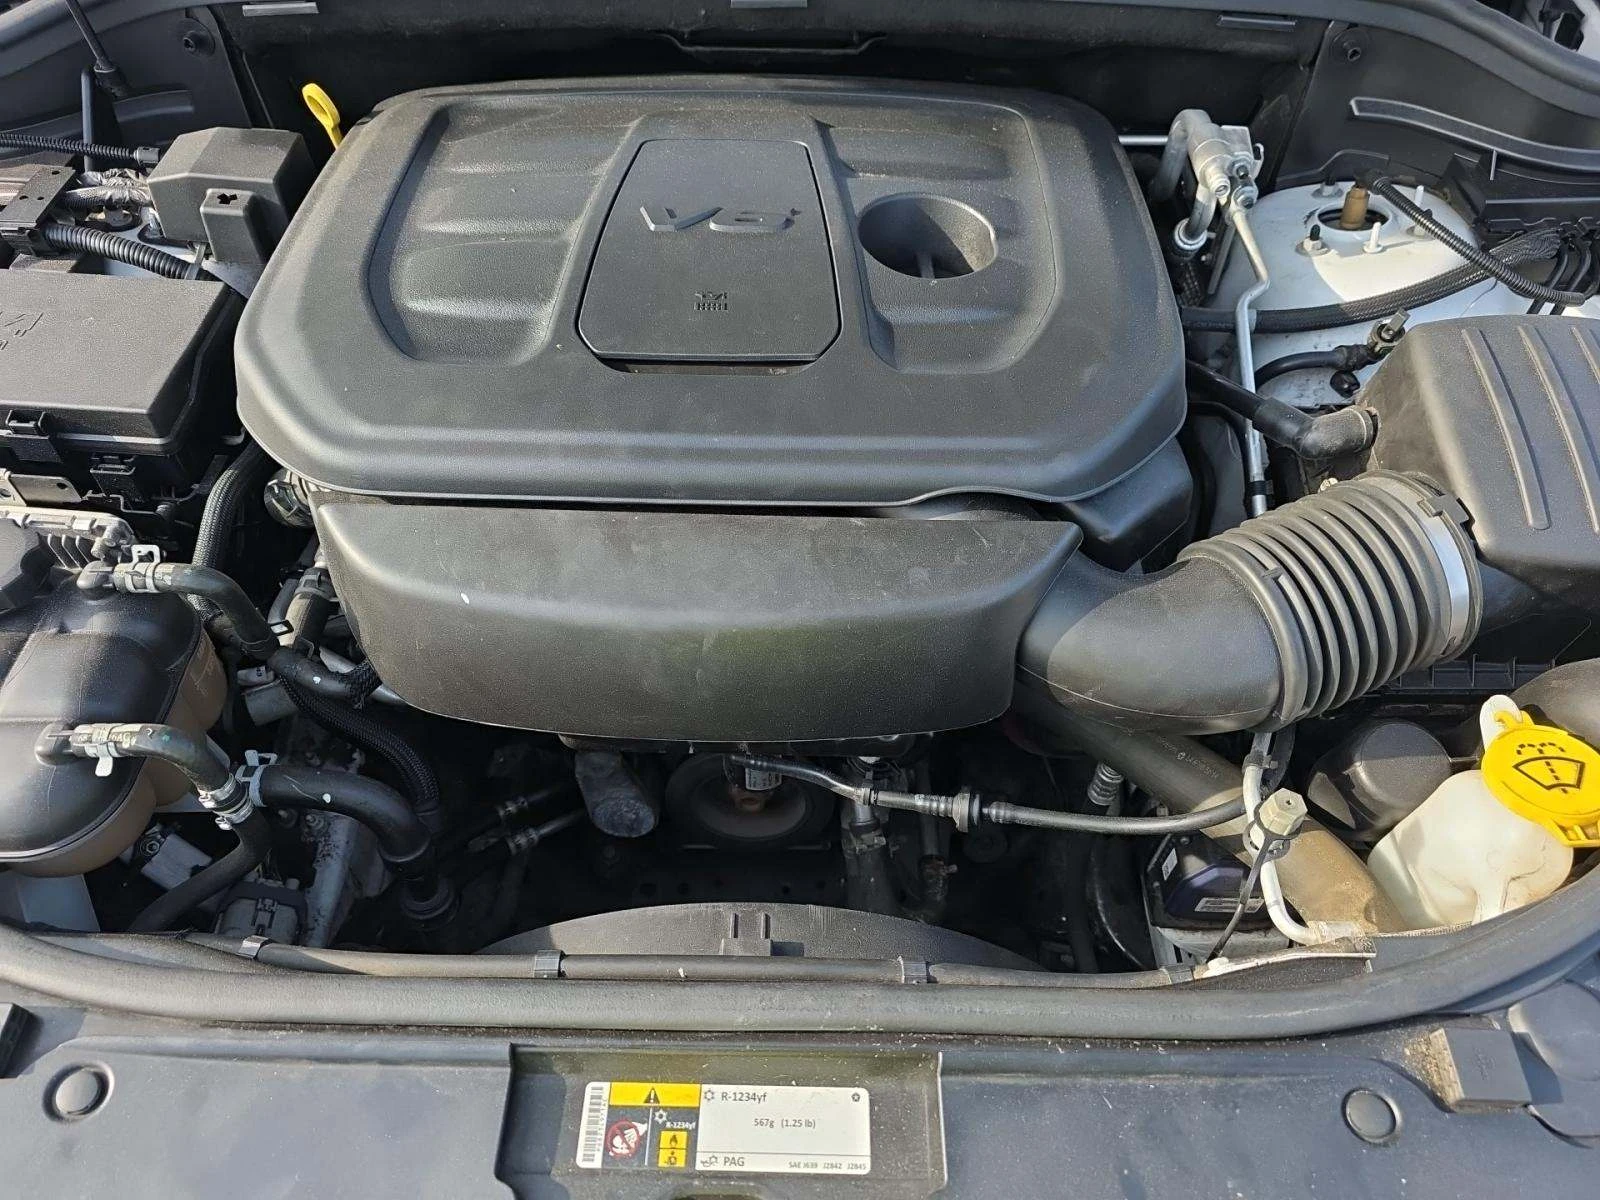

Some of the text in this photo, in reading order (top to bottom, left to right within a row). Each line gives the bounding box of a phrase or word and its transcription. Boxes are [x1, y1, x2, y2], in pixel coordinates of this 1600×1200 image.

[721, 1091, 767, 1104] R-1234yf
[753, 1118, 816, 1129] 567g (1.25 lb)
[723, 1156, 745, 1167] PAG
[788, 1161, 801, 1169] SAE
